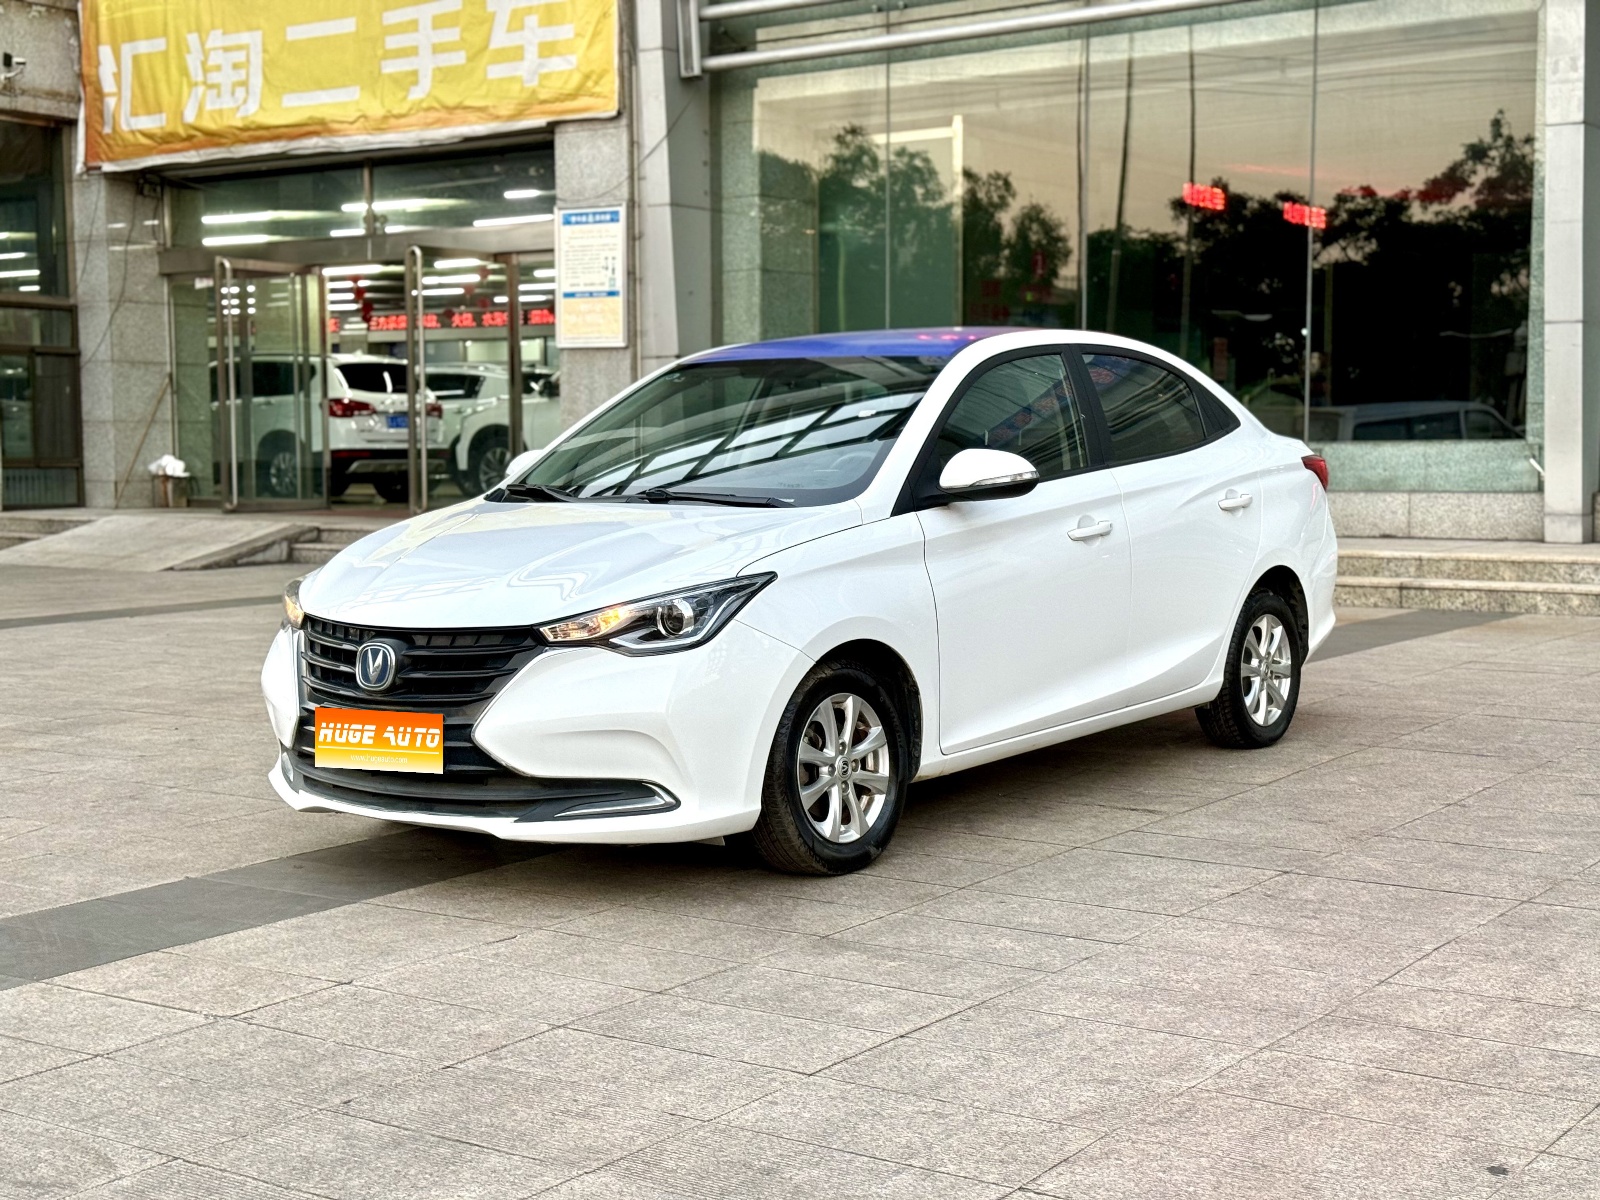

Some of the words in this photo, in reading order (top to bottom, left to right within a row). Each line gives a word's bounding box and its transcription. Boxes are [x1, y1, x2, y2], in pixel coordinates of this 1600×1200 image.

[97, 0, 578, 135] 汇淘二手车
